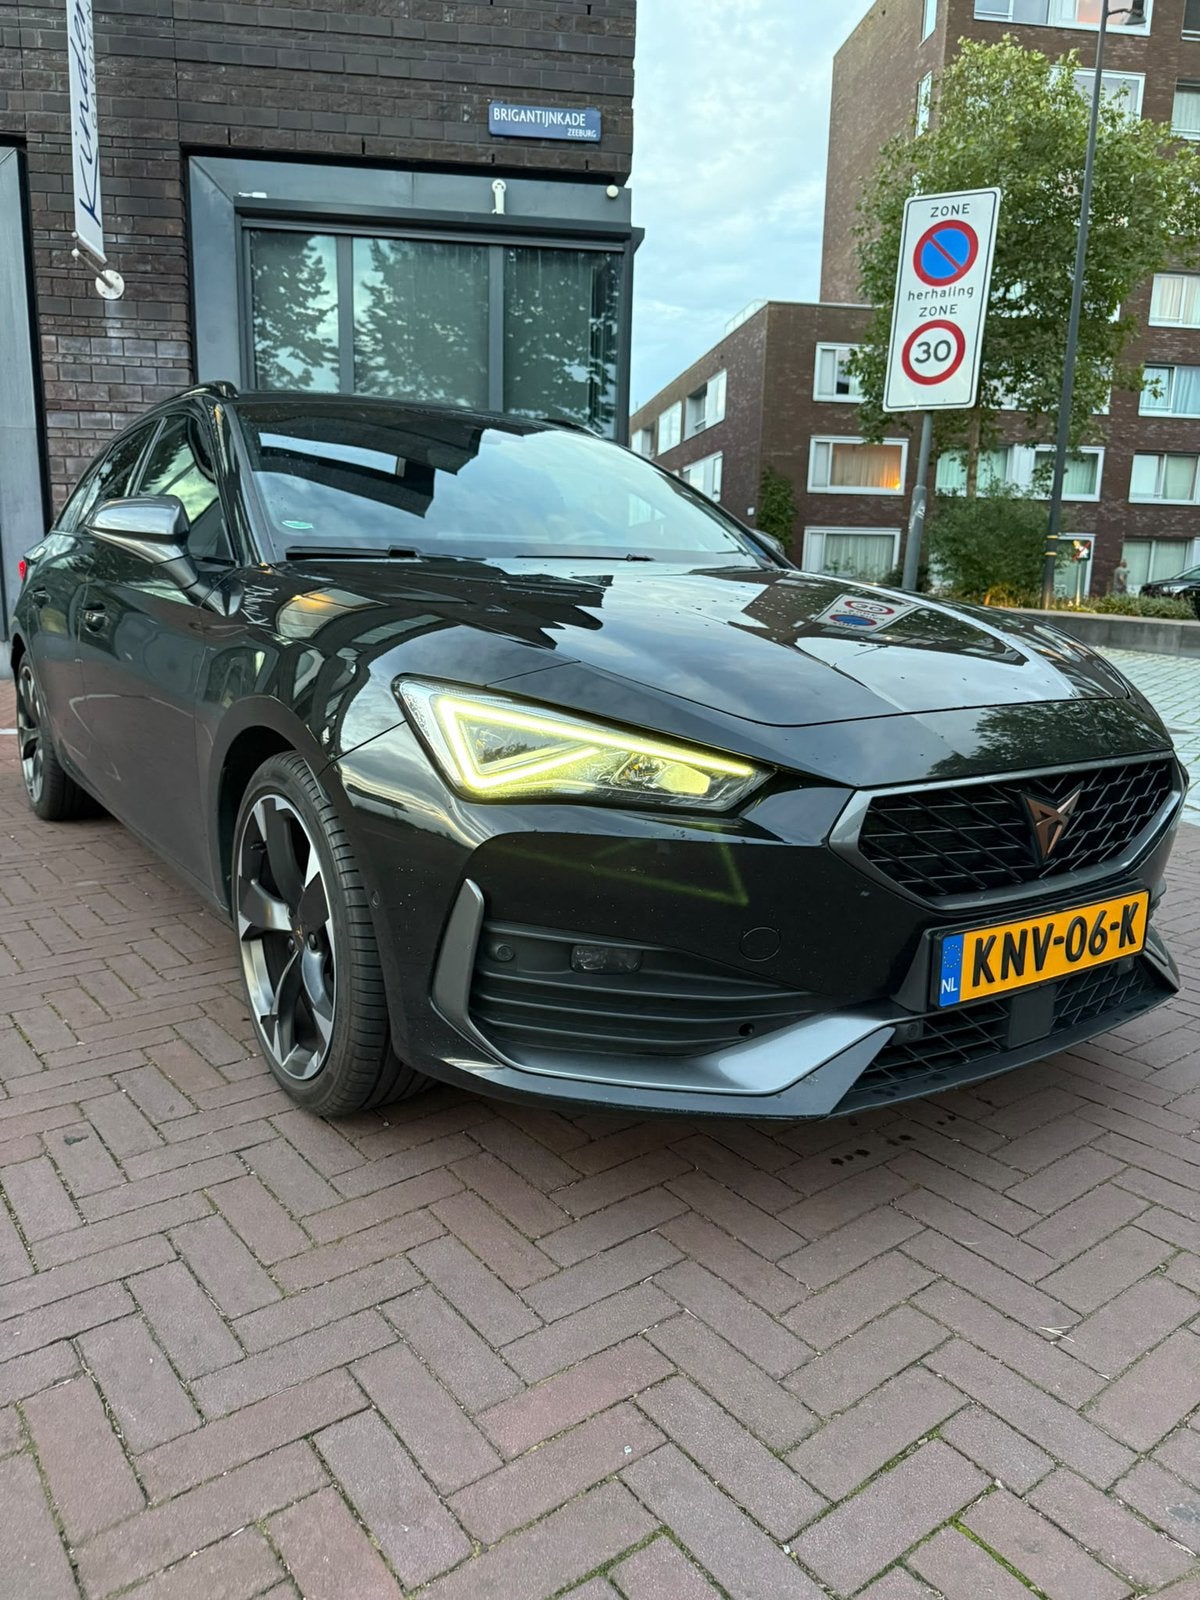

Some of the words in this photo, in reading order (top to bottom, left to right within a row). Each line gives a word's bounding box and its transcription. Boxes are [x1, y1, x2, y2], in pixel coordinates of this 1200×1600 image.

[493, 108, 586, 127] BRIGANTIJNKADE
[567, 128, 597, 138] ZEEBURG
[930, 203, 971, 218] ZONE
[908, 286, 974, 301] herhaling
[919, 304, 958, 318] ZONE
[914, 340, 952, 364] 30
[972, 902, 1140, 987] KNV-06-K
[941, 976, 958, 995] NL
